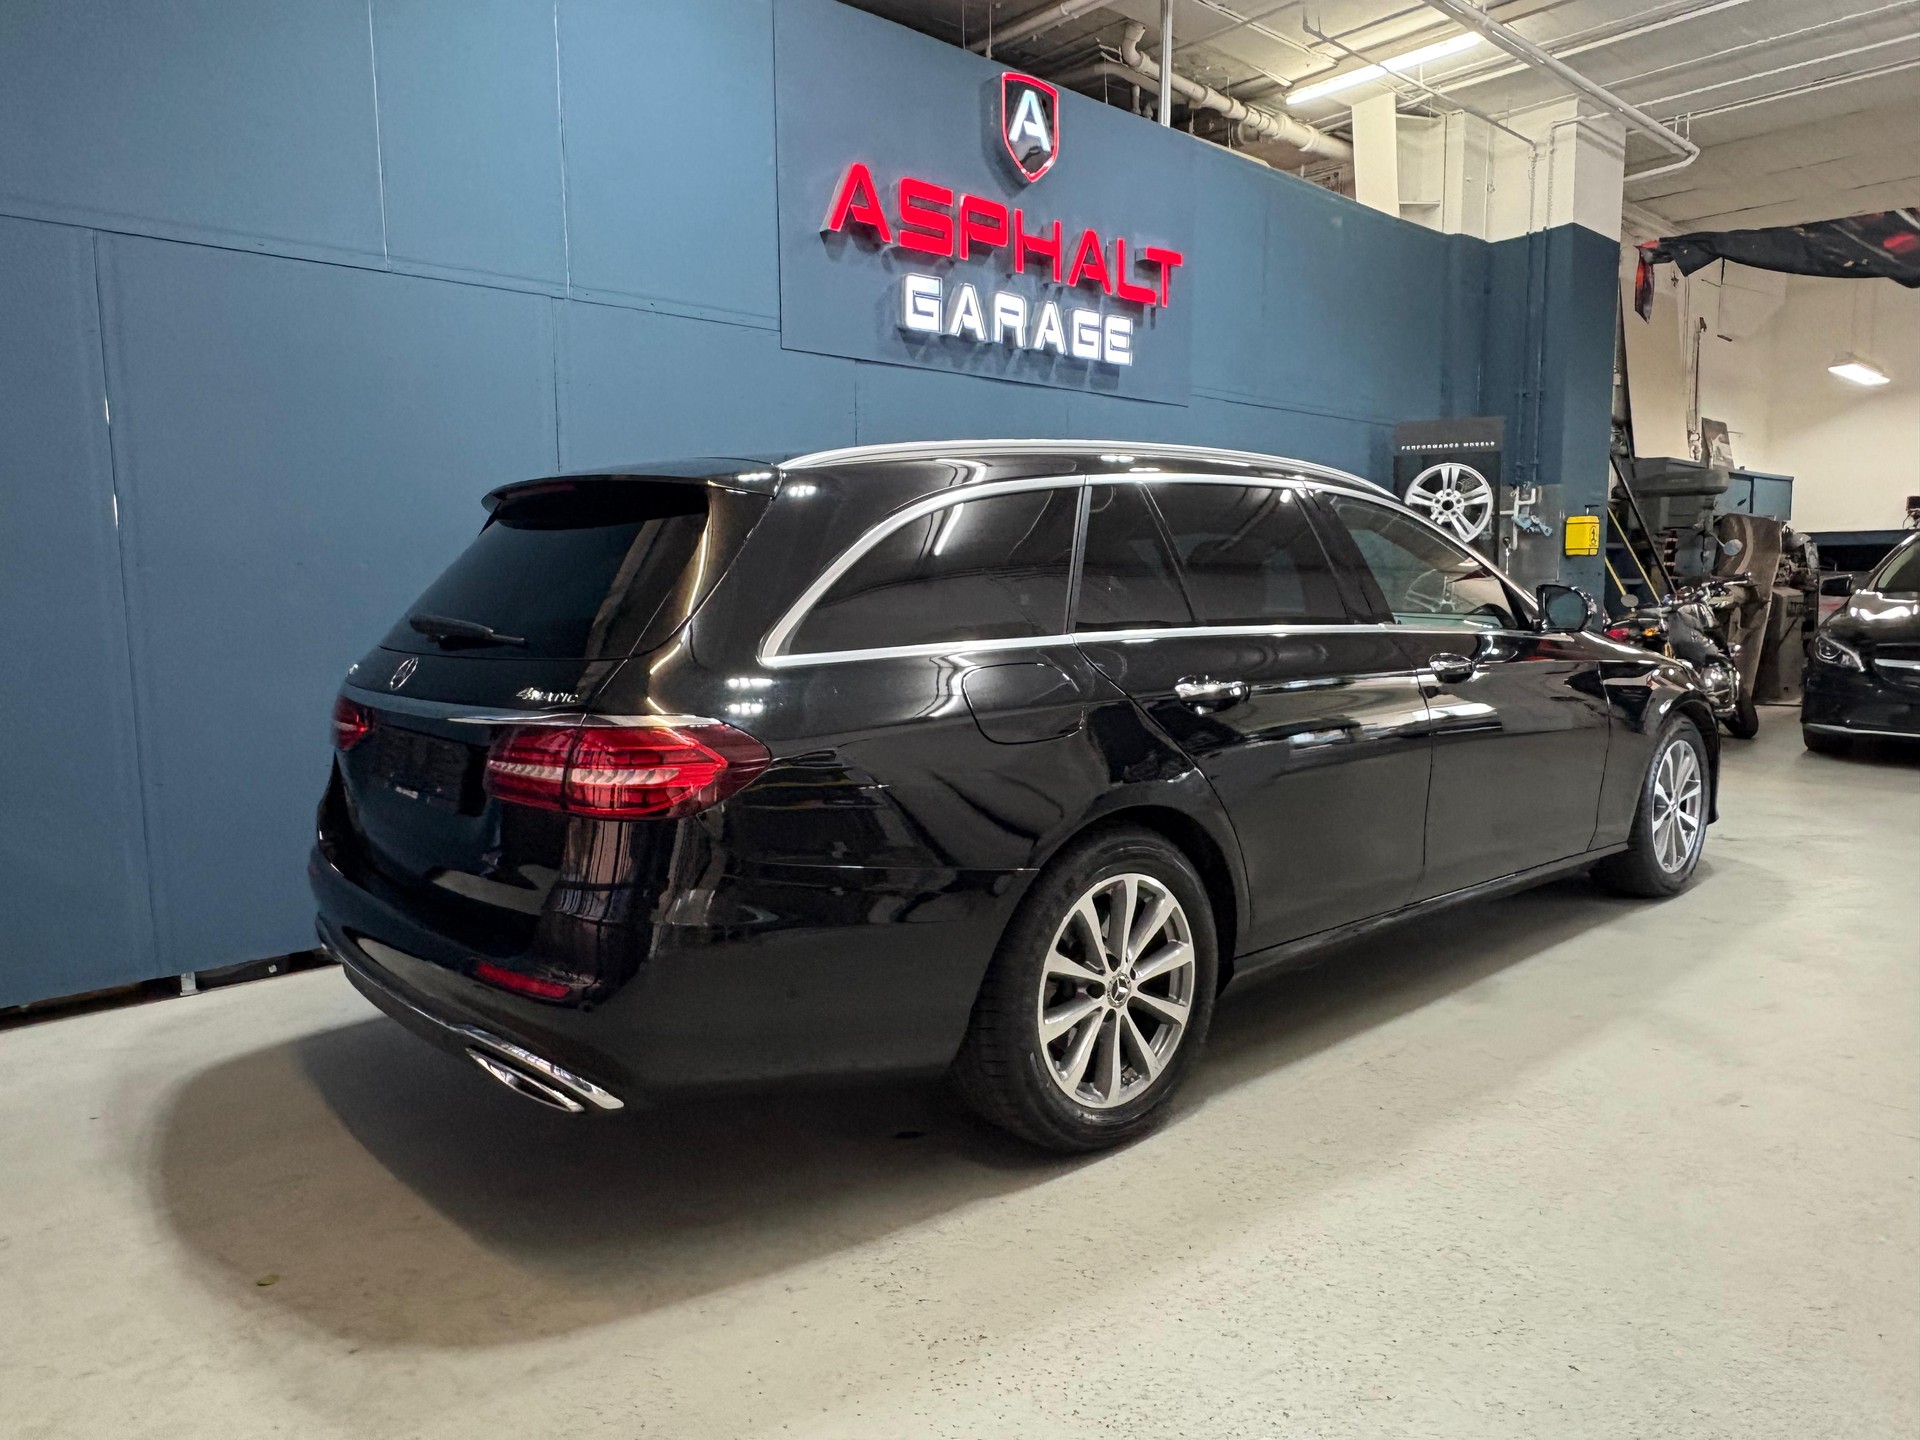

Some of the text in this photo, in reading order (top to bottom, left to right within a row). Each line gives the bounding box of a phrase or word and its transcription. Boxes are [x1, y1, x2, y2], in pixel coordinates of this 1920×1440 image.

[1008, 89, 1052, 153] A
[828, 162, 1184, 308] ASPHALT
[904, 272, 1134, 367] GARAGE
